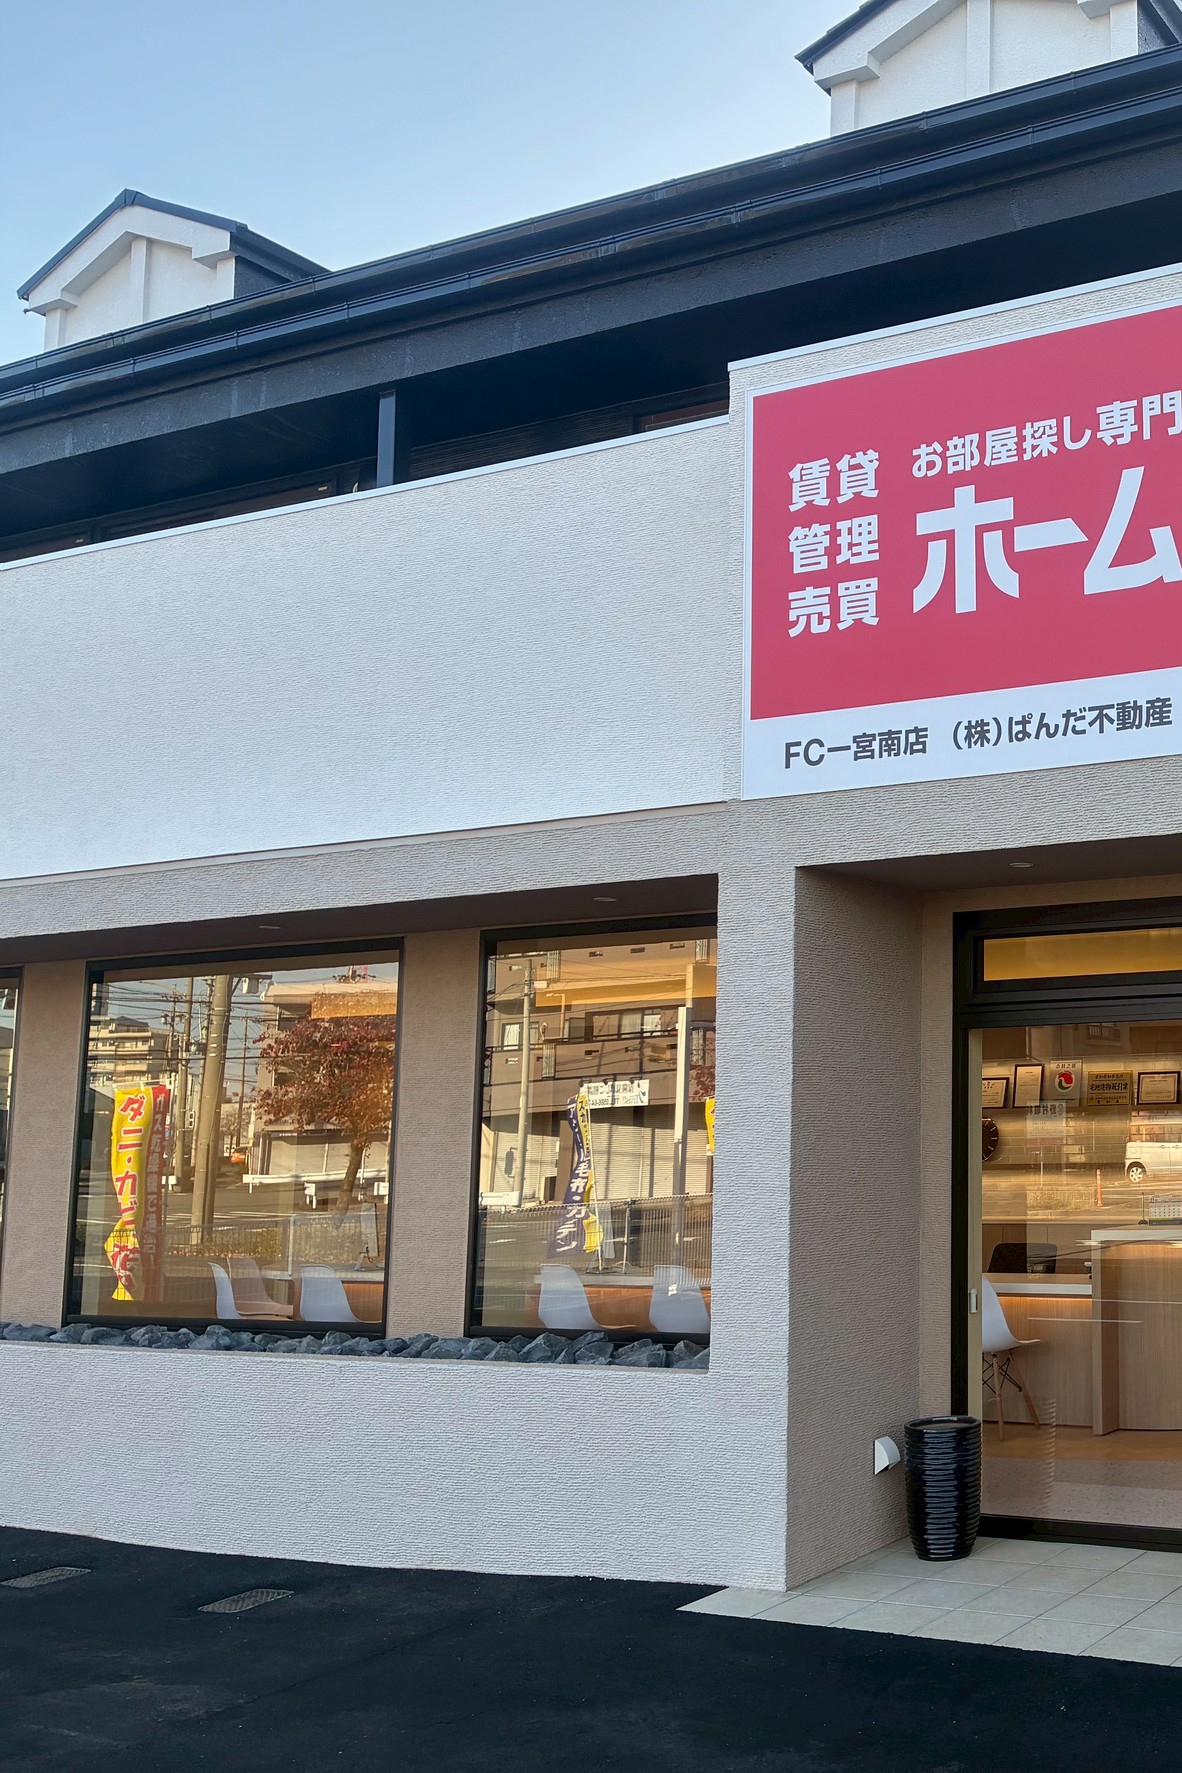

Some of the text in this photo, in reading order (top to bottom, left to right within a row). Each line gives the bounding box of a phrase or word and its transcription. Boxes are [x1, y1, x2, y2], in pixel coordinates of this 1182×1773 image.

[789, 449, 879, 512] 賃貸
[789, 515, 879, 573] 管理
[789, 577, 879, 637] 売買
[785, 726, 929, 769] FC一宮南店
